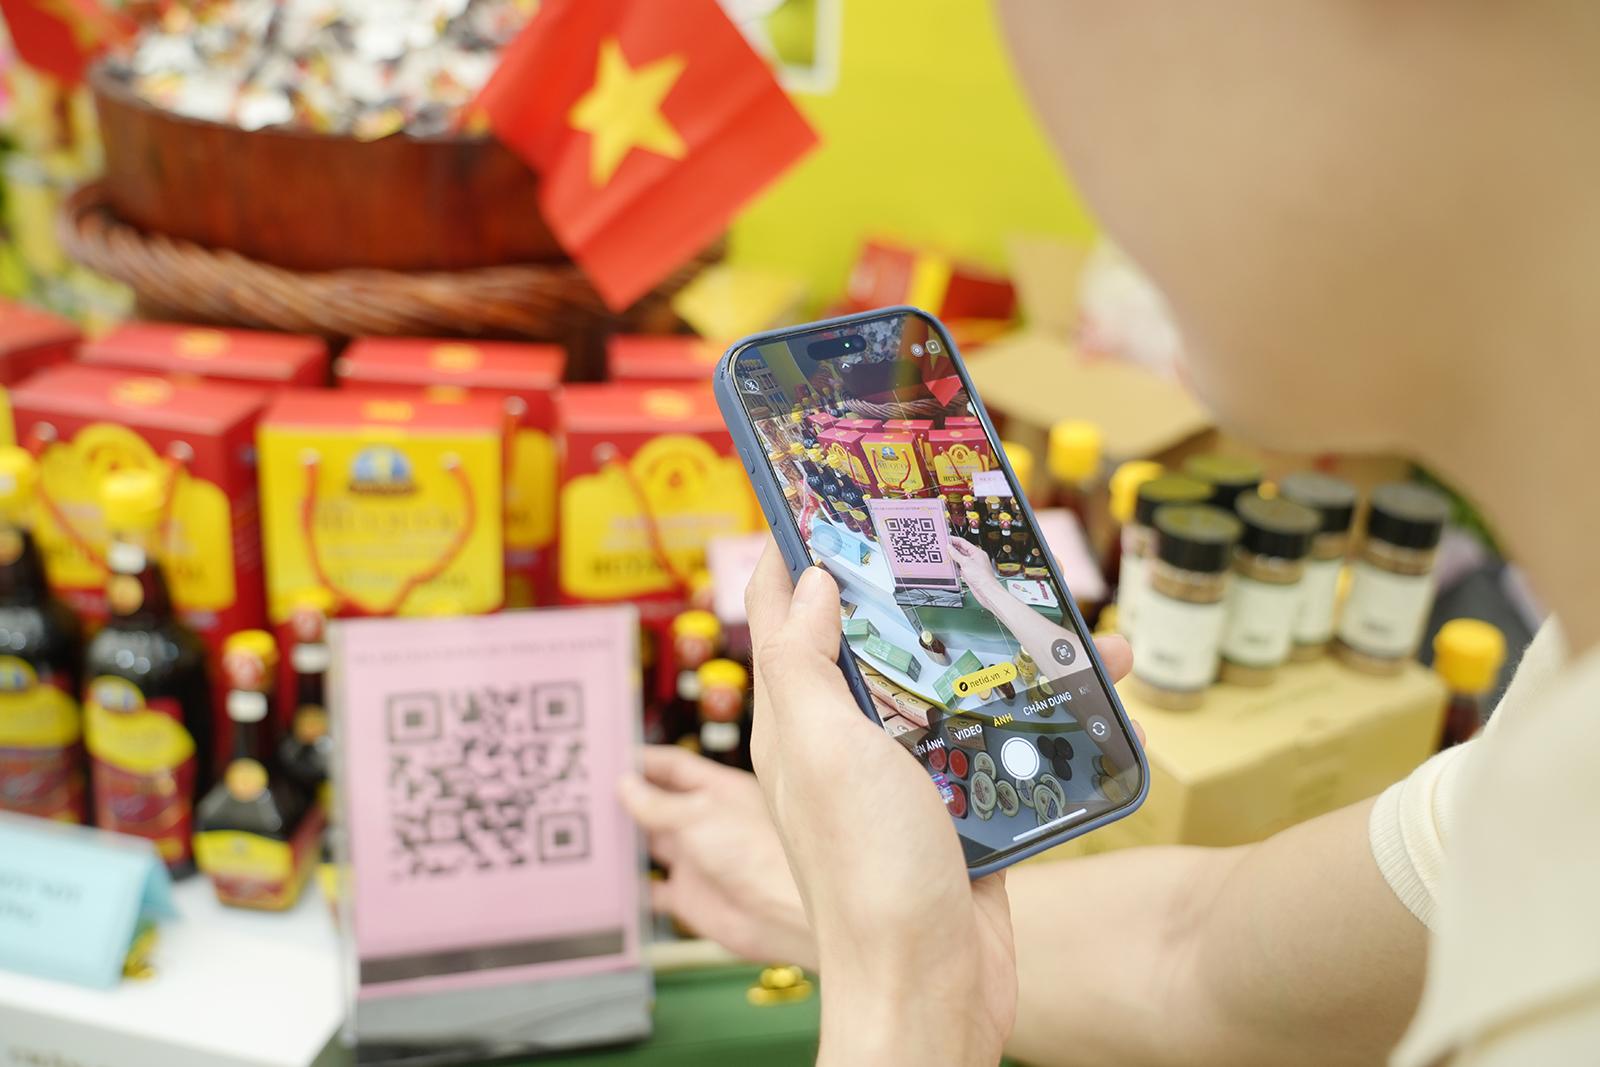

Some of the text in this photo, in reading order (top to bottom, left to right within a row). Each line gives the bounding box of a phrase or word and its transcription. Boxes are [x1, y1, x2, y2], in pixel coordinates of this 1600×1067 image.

[970, 673, 1000, 688] netid.vn
[926, 737, 945, 752] ẢNH
[954, 723, 983, 741] VIDEO
[993, 713, 1013, 727] ẢNH
[1023, 699, 1049, 716] CHÂN
[1047, 691, 1072, 707] DUNG
